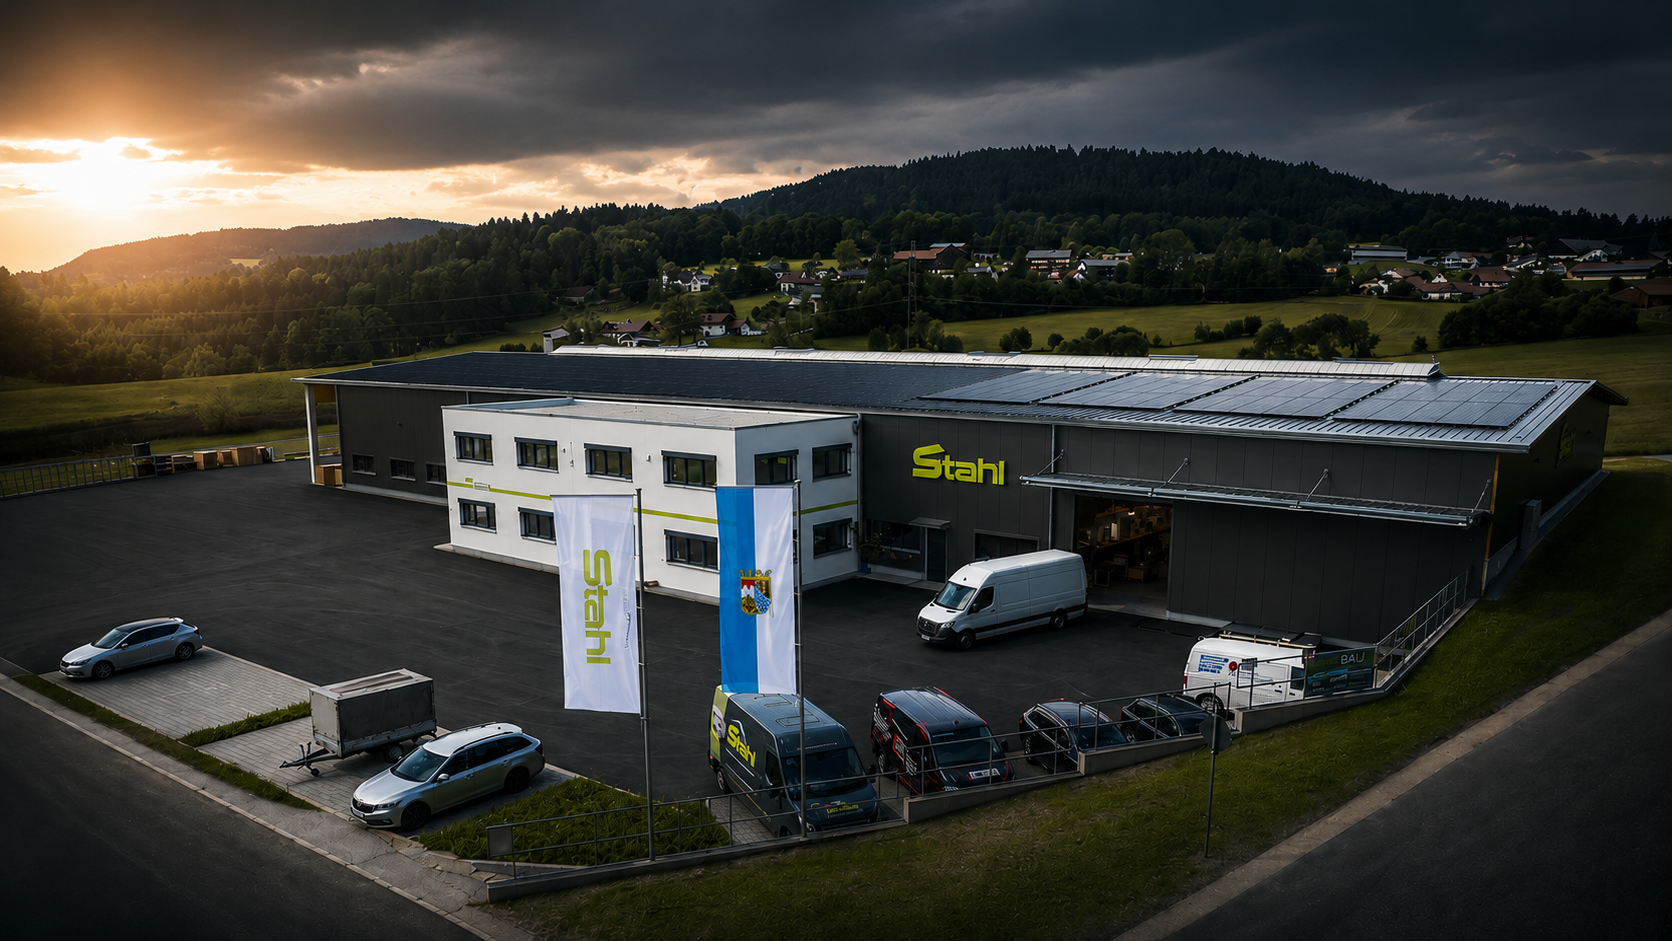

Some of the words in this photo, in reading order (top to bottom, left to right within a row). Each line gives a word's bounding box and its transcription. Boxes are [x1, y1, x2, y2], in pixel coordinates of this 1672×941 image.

[912, 443, 1005, 486] Stahl
[583, 549, 613, 665] Stahl
[1340, 651, 1365, 665] BAU
